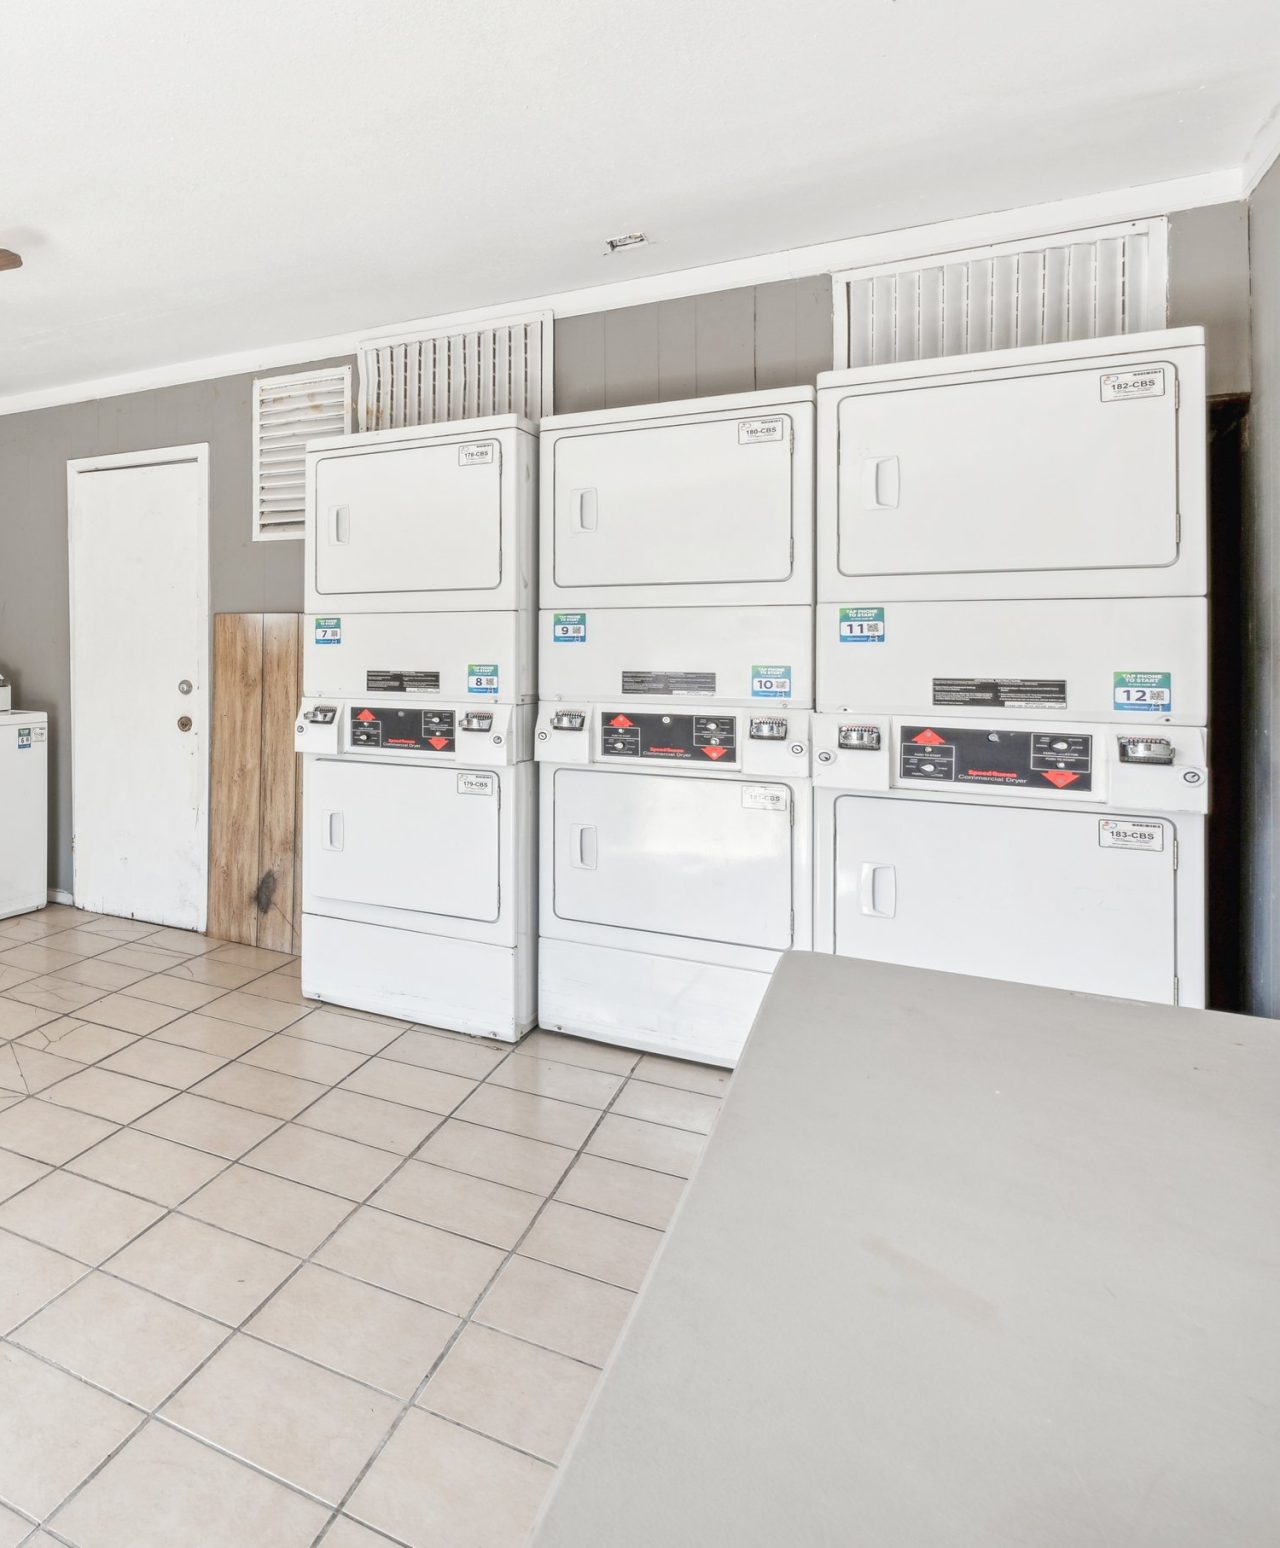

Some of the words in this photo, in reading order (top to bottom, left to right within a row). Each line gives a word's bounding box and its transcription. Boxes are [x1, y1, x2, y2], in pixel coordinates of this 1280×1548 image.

[1112, 379, 1156, 390] 182-CBS
[746, 426, 777, 435] 180-CBS
[561, 626, 569, 635] 9
[846, 623, 864, 634] 11
[322, 630, 328, 638] 7
[475, 677, 483, 686] 8
[757, 680, 773, 690] 10
[1123, 689, 1147, 702] 12
[958, 774, 1004, 782] Commercial
[1006, 776, 1028, 784] Dryer
[1110, 830, 1154, 840] 183-CBS
